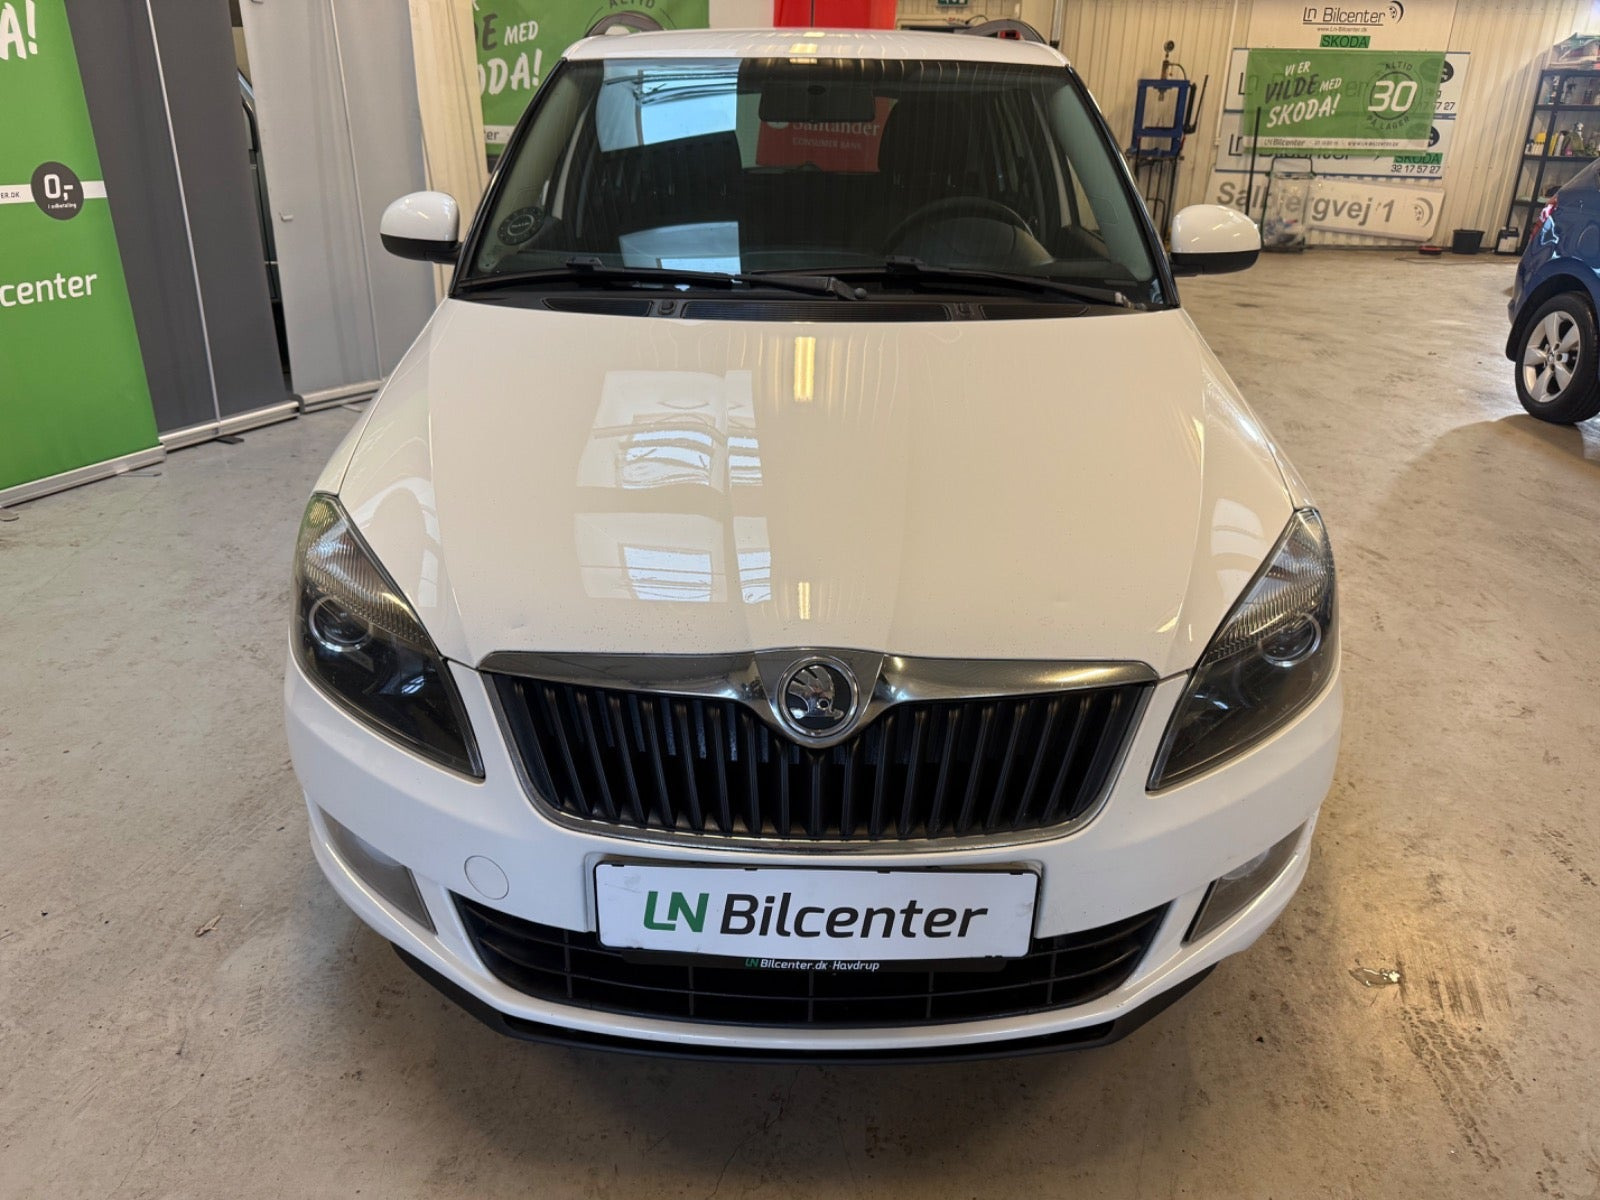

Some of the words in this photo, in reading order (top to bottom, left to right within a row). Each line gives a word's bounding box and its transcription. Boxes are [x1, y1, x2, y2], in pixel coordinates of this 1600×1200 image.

[1303, 7, 1317, 22] Ln
[1323, 7, 1385, 23] Bilcenter
[475, 12, 498, 51] E
[504, 20, 538, 46] MED
[1321, 35, 1369, 48] SKODA
[1284, 64, 1295, 77] VI
[1297, 61, 1311, 74] ER
[1385, 61, 1413, 71] ALTID
[1265, 73, 1319, 105] VILDE
[1320, 77, 1342, 92] MED
[1367, 80, 1418, 112] 30
[1266, 93, 1341, 129] SKODA!
[1443, 101, 1456, 111] 27
[1380, 115, 1410, 130] LAGER
[1390, 164, 1402, 173] 32
[1404, 165, 1415, 173] 17
[1417, 165, 1428, 174] 57
[1429, 165, 1441, 174] 27
[643, 890, 710, 933] LN
[719, 892, 989, 939] Bilcenter
[832, 960, 880, 972] Havdrup
